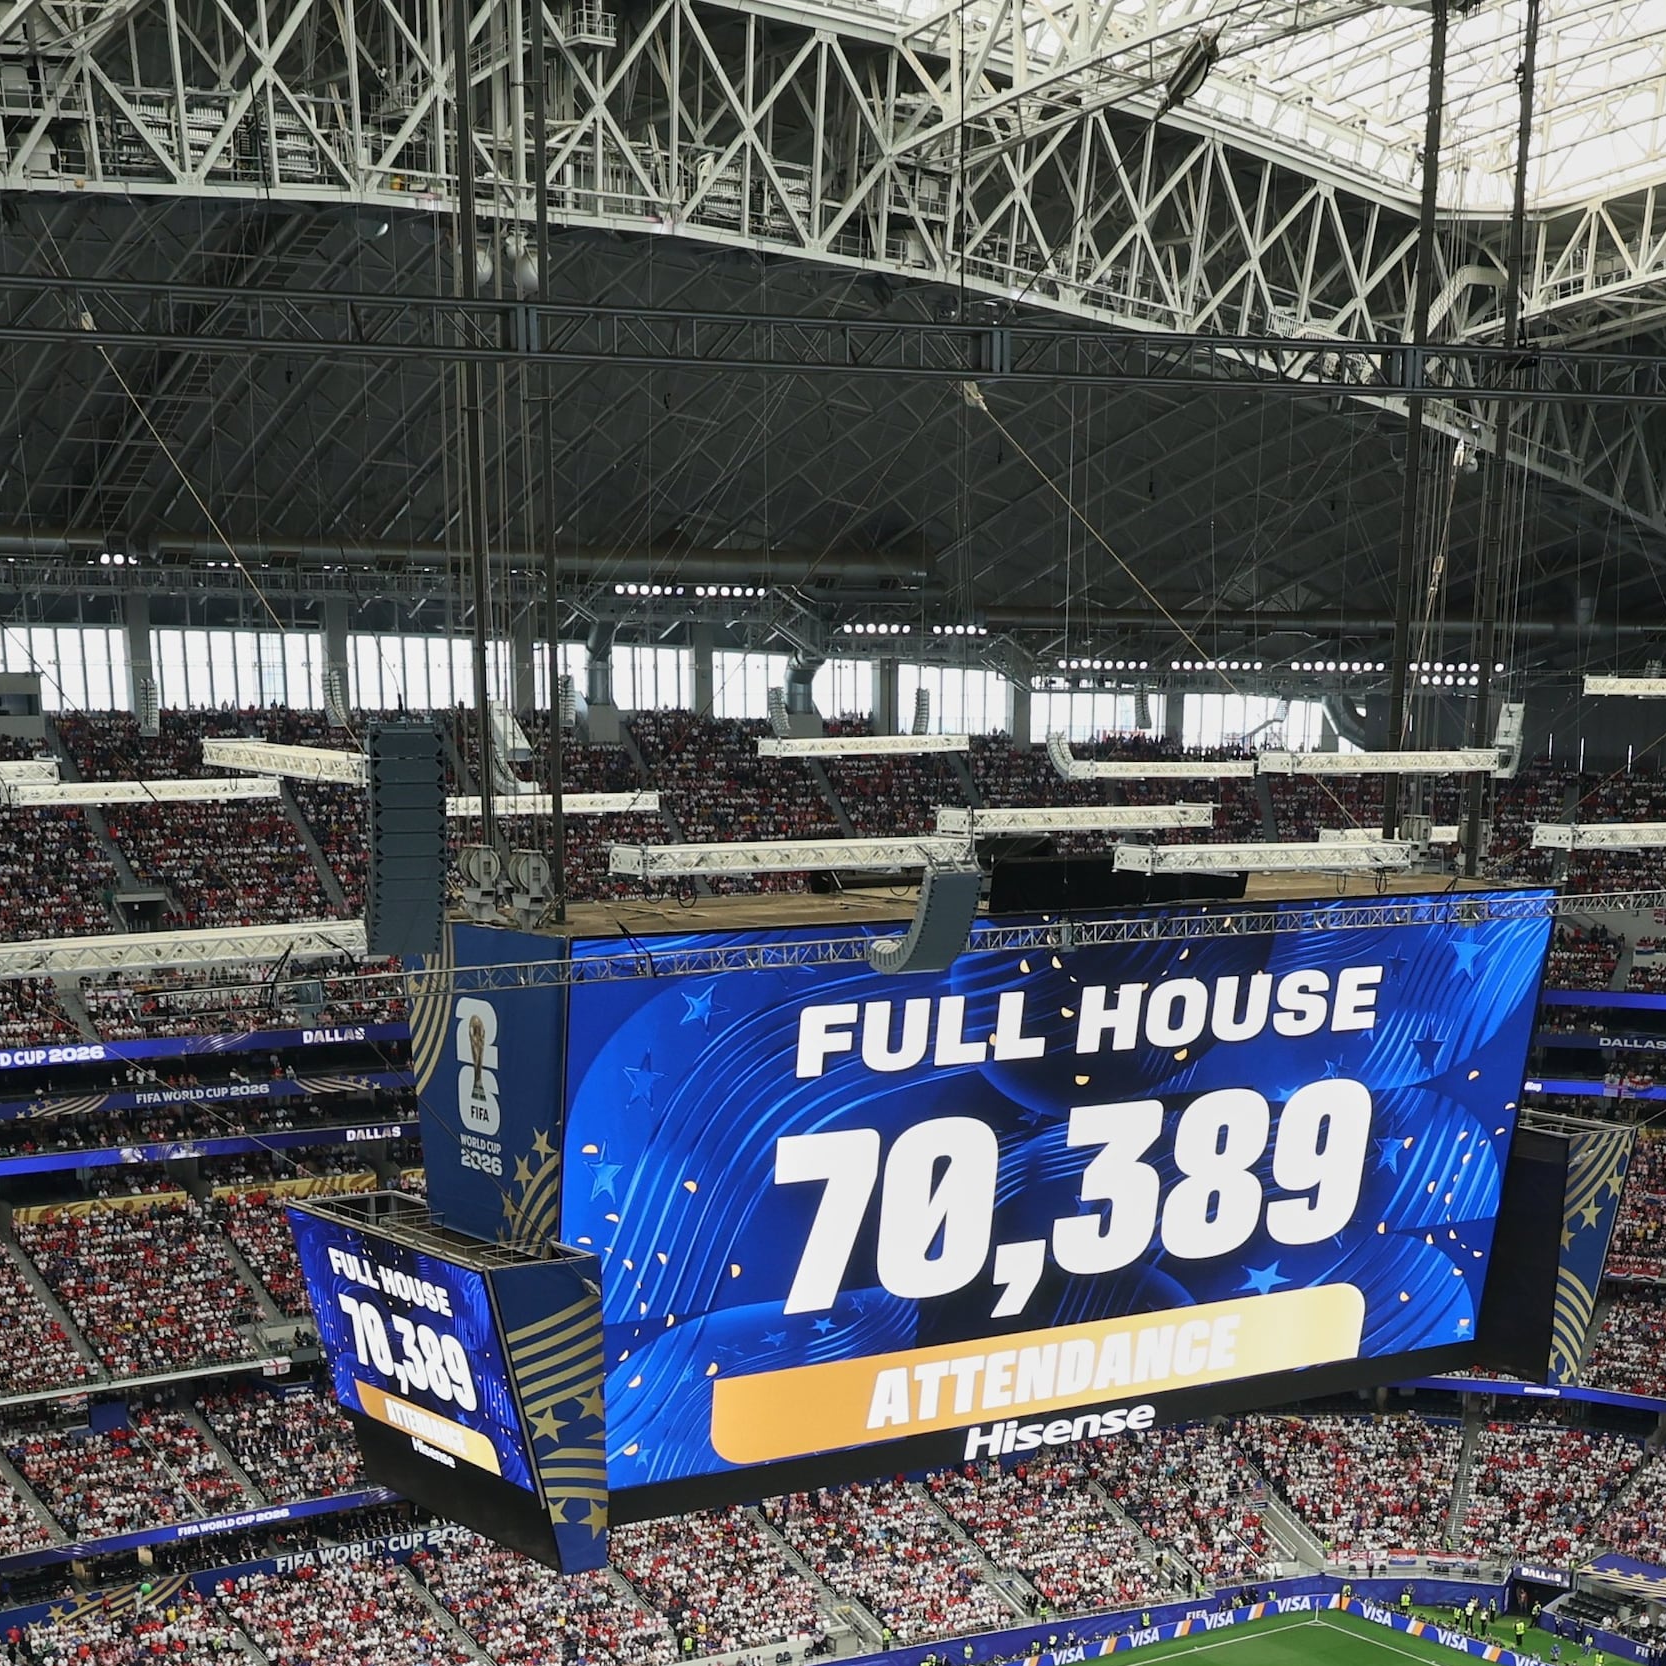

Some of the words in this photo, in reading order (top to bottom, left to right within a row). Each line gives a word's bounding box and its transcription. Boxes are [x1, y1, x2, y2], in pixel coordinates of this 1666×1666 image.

[796, 992, 1045, 1078] FULL
[1074, 966, 1383, 1055] HOUSE
[303, 1028, 365, 1043] DALLAS
[1600, 1038, 1666, 1049] DALLAS
[14, 1050, 46, 1065] CUP
[49, 1046, 105, 1062] 2026
[136, 1093, 161, 1104] FIFA
[163, 1086, 204, 1105] WORLD
[206, 1087, 228, 1098] CUP
[231, 1084, 269, 1096] 2026
[470, 1104, 491, 1124] FIFA
[345, 1124, 401, 1142] DALLAS
[460, 1132, 485, 1152] WORLD
[485, 1141, 501, 1154] CUP
[461, 1149, 502, 1175] 2026
[774, 1077, 1373, 1319] 70,389
[328, 1246, 381, 1291] FULL
[380, 1267, 453, 1317] HOUSE
[338, 1293, 478, 1411] 70,389
[865, 1313, 1238, 1430] ATTENDANCE
[964, 1400, 1155, 1461] Hisense
[412, 1438, 456, 1469] Hisense
[177, 1524, 201, 1537] FIFA
[202, 1518, 235, 1534] WORLD
[236, 1513, 255, 1526] CUP
[256, 1507, 290, 1522] 2026
[388, 1533, 423, 1553] CUP
[1520, 1566, 1562, 1583] DALLAS
[1187, 1608, 1208, 1621] FIFA
[1275, 1596, 1311, 1614] VISA
[1361, 1604, 1393, 1627] VISA
[1128, 1627, 1160, 1648] VISA
[1435, 1628, 1470, 1654] VISA
[1050, 1644, 1086, 1665] VISA
